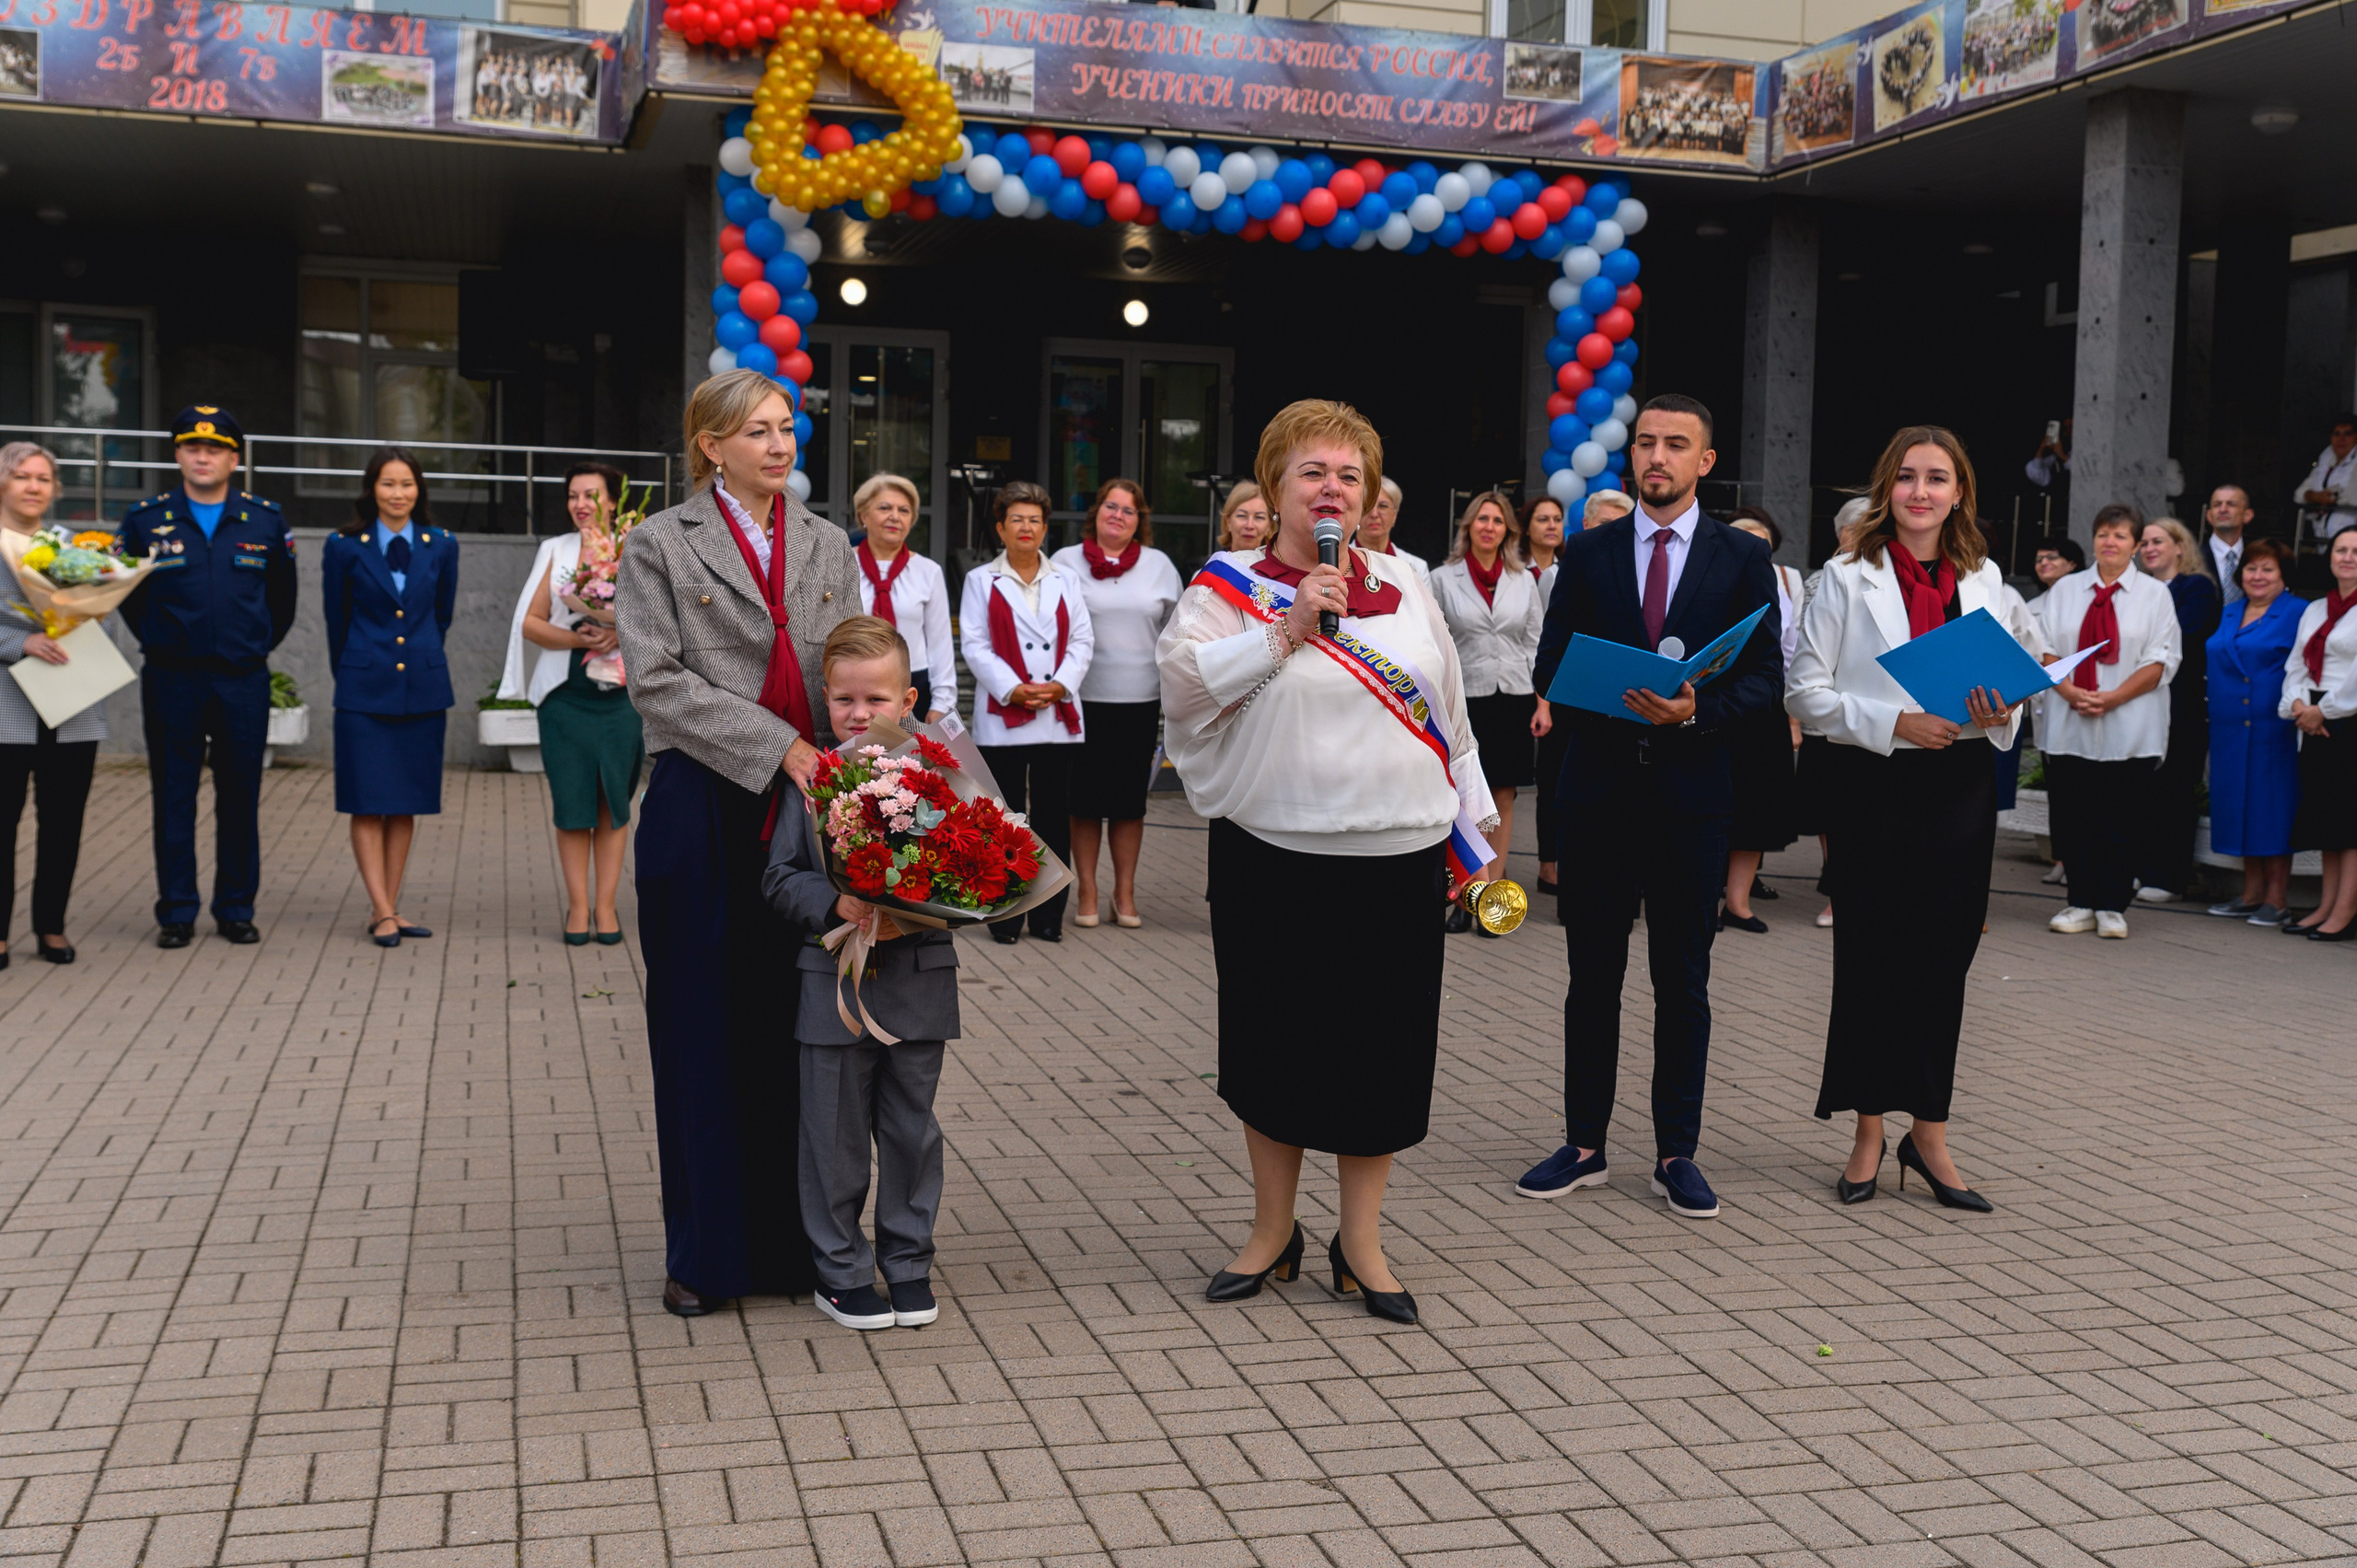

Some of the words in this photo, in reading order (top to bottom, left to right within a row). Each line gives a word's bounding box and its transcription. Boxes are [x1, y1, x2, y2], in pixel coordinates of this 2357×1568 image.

[169, 41, 200, 75] И
[976, 6, 1203, 55] УЧИТЕЛЯМИ
[1212, 32, 1360, 71] СЛАВИТСЯ
[1369, 43, 1495, 87] РОССИЯ,
[147, 75, 229, 111] 2018
[1072, 62, 1234, 108] УЧЕНИКИ
[1241, 83, 1393, 122] ПРИНОСЯТ
[1399, 98, 1490, 129] СЛАВУ
[1494, 103, 1539, 133] ЕЙ!
